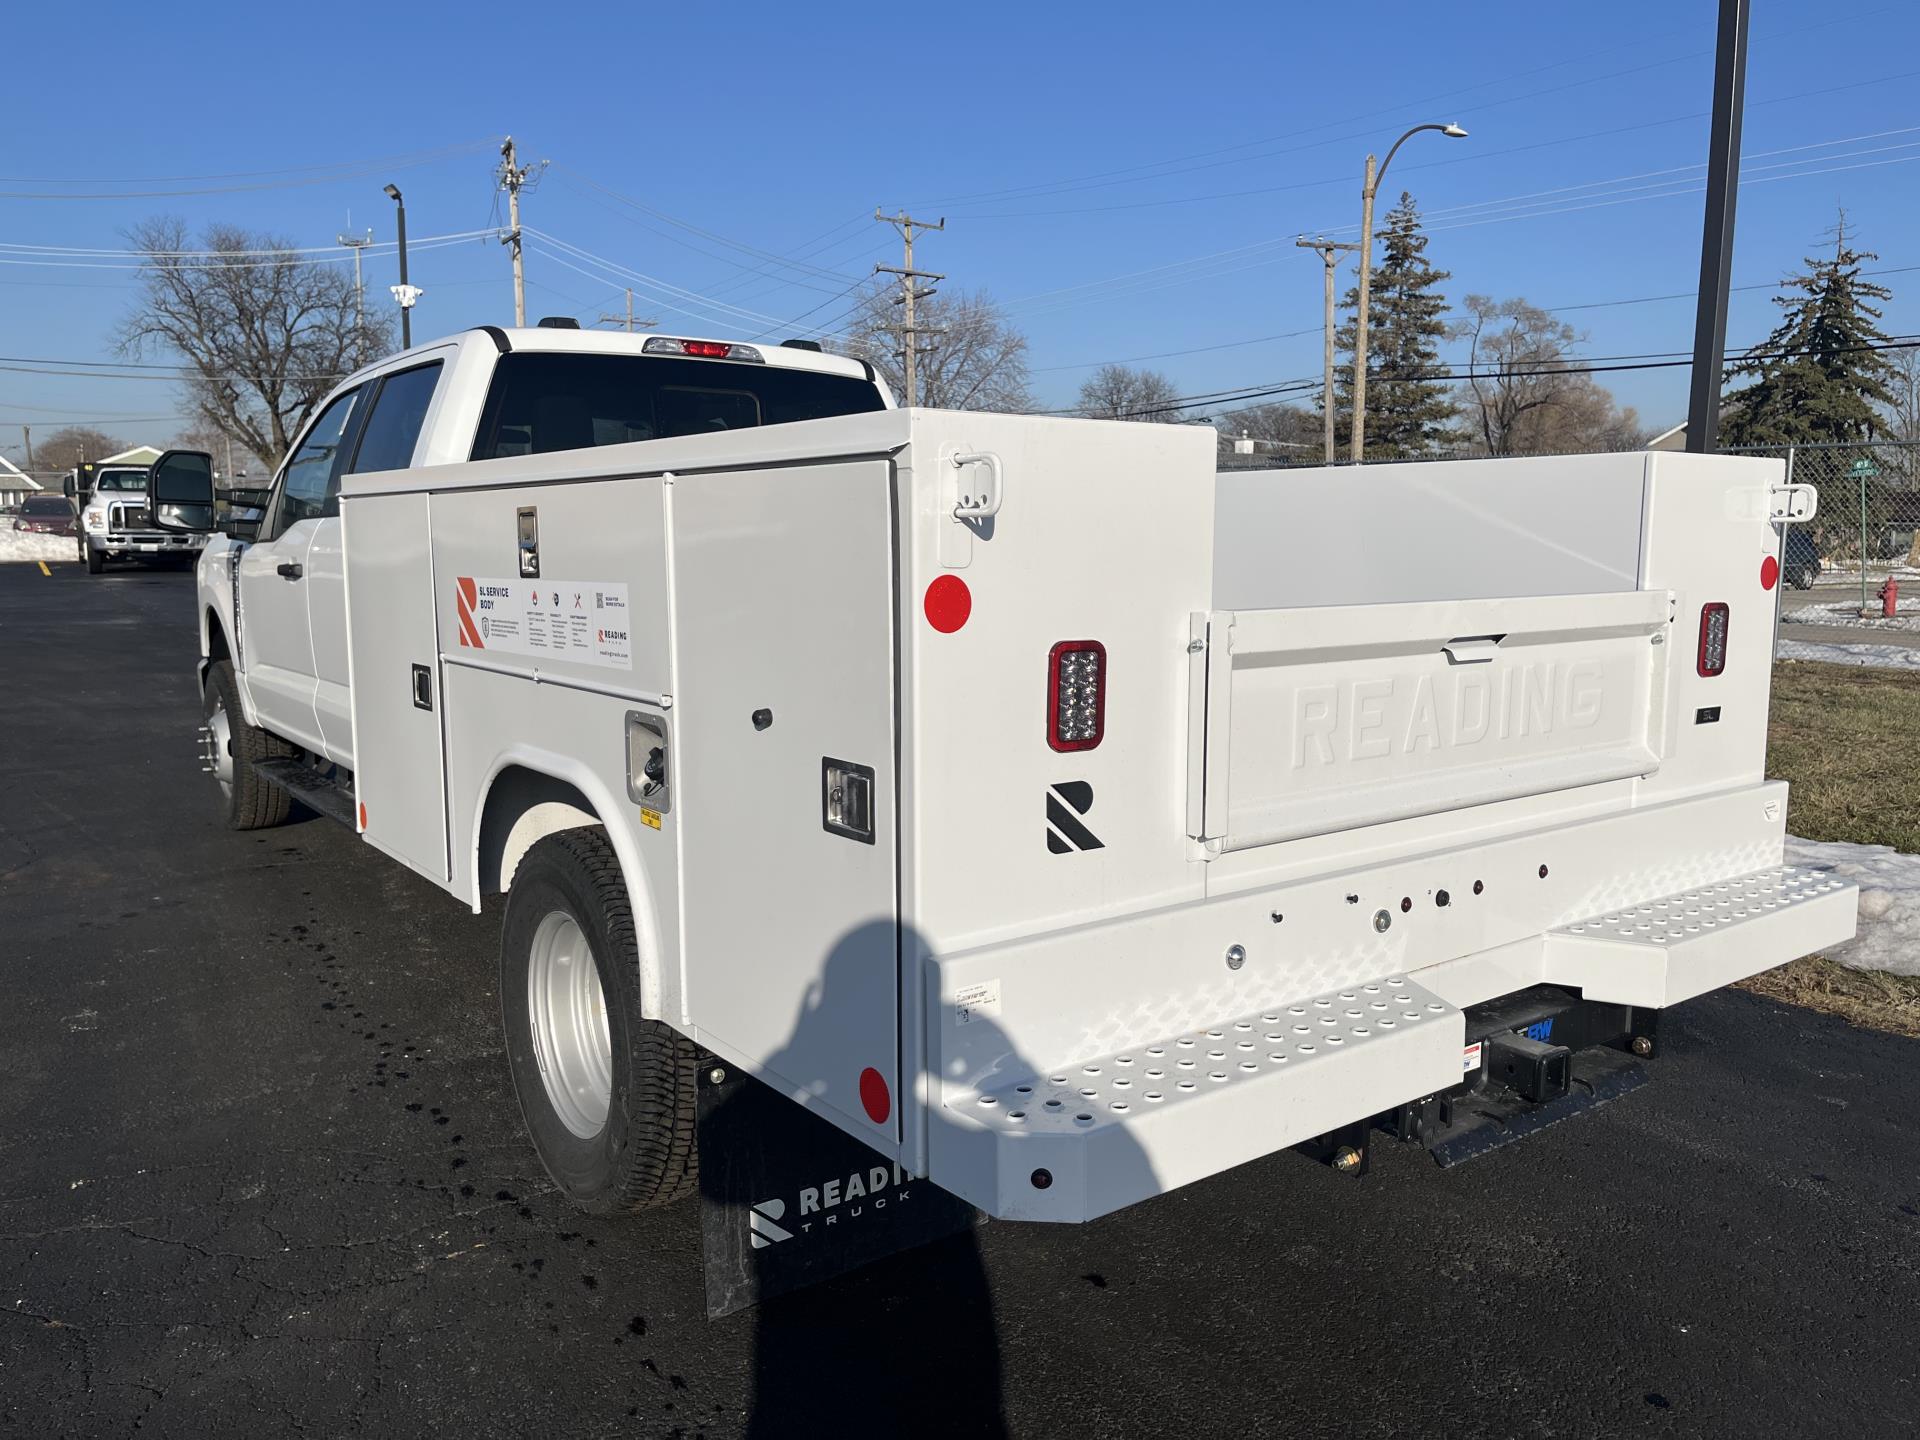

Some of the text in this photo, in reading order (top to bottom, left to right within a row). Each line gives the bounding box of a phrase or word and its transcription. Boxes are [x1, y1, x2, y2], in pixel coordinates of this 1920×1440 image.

[479, 586, 509, 598] SL SERVICE
[480, 599, 494, 610] BODY
[604, 630, 627, 640] READING
[1291, 661, 1606, 771] READING
[799, 1162, 915, 1216] READI
[802, 1190, 910, 1233] TRUCK
